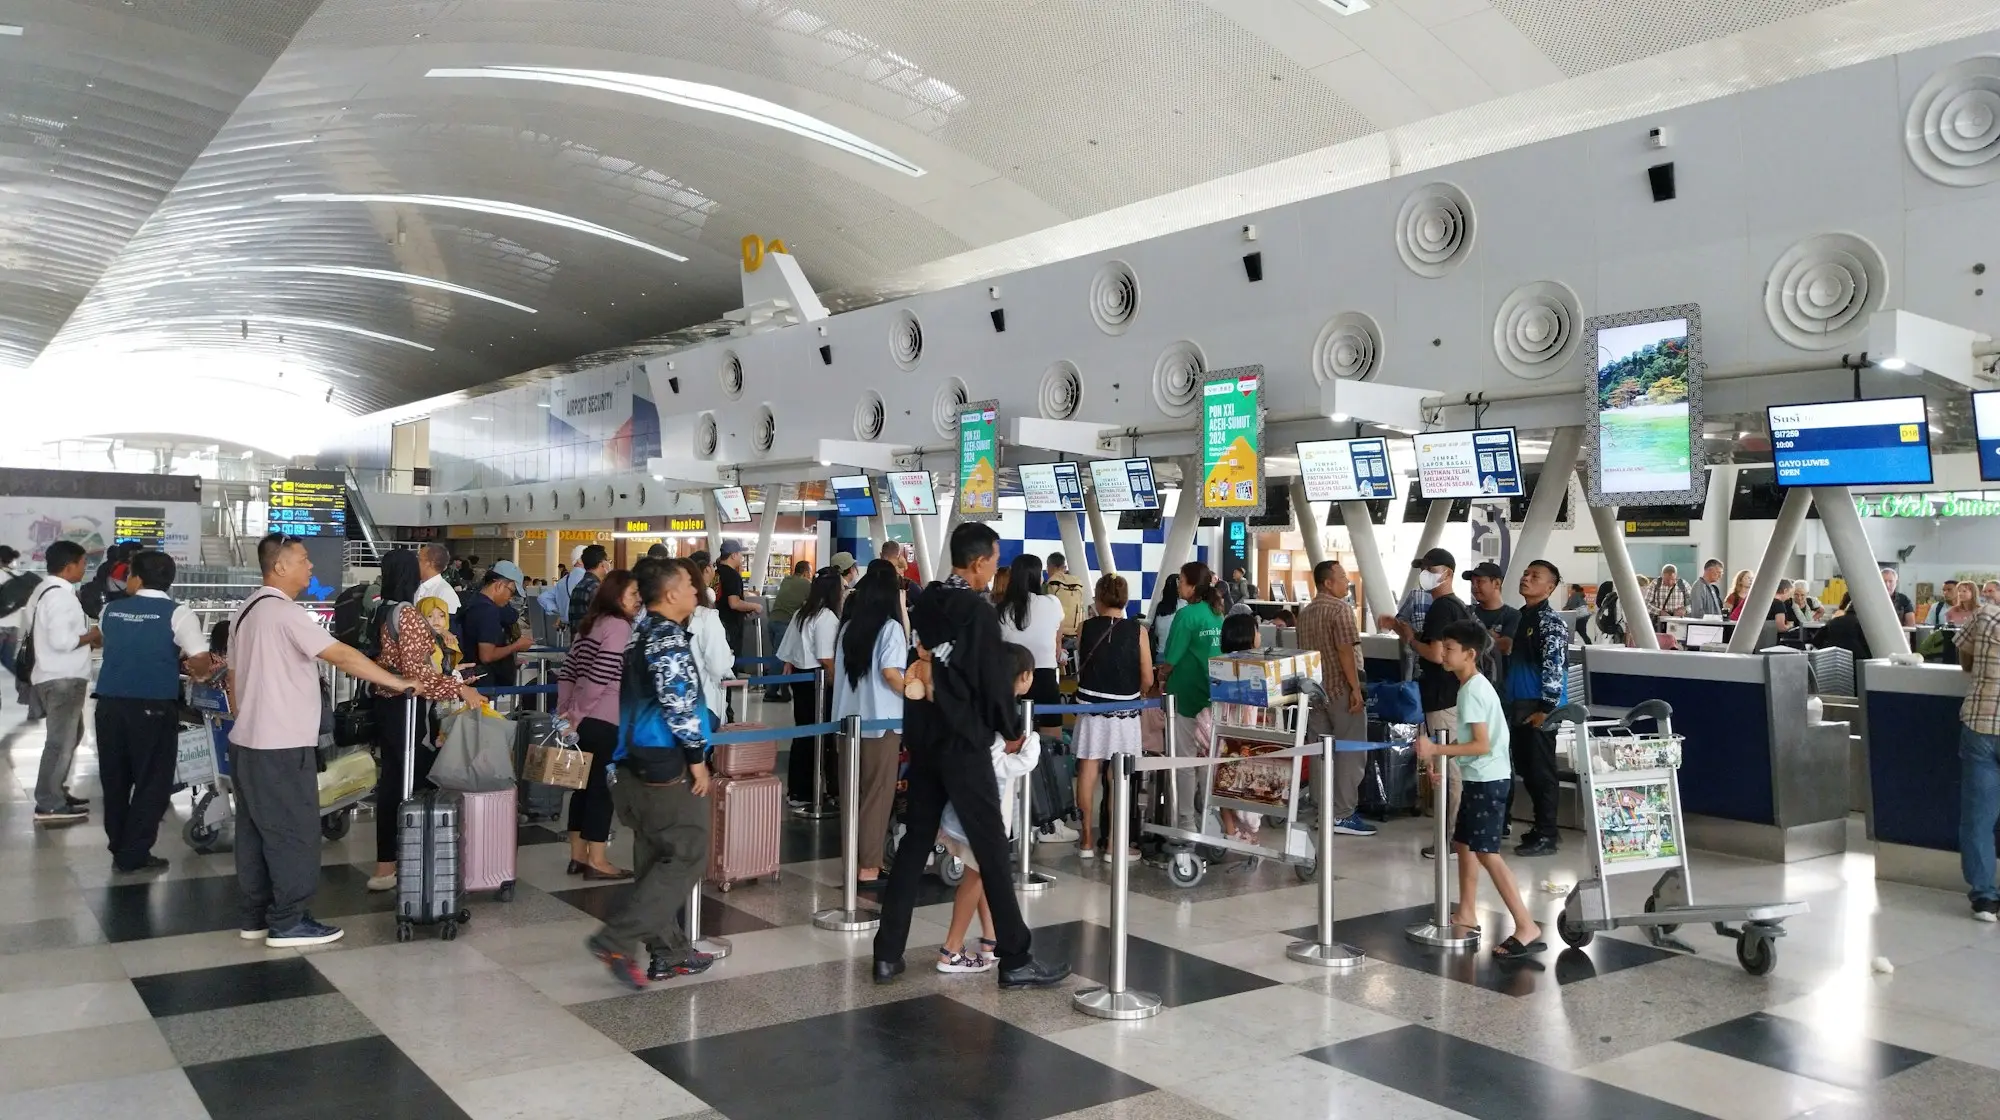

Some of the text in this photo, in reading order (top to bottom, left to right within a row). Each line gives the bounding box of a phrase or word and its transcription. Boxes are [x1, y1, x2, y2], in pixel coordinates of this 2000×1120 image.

[566, 392, 613, 416] AIRPORT SECURITY
[1209, 403, 1235, 418] PON XXI
[1209, 415, 1250, 431] ACEH-SUMUT
[1773, 413, 1800, 423] Susi
[1209, 431, 1226, 445] 2024
[1778, 460, 1801, 468] GAYO
[295, 482, 334, 490] Keberangkatan
